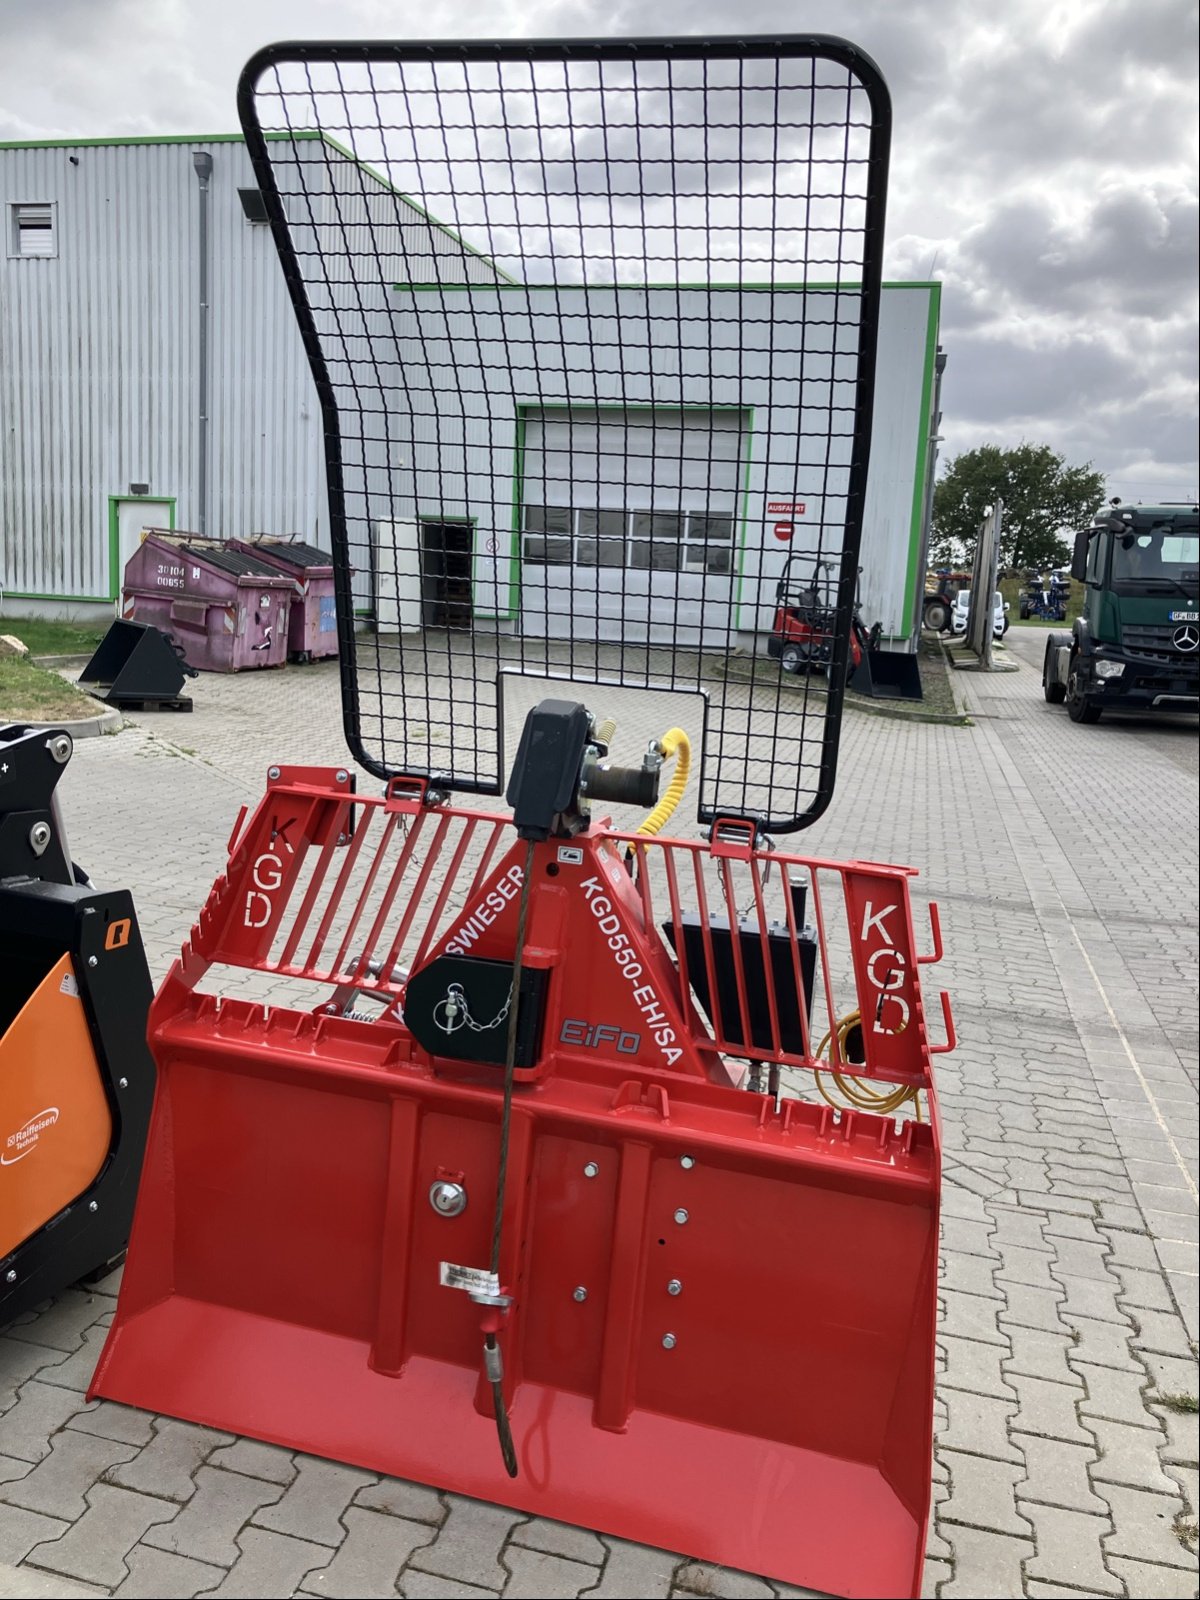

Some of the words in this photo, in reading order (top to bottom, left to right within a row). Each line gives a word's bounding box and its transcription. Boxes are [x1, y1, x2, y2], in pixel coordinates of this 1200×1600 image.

[244, 815, 297, 929] KGD
[579, 875, 684, 1066] KGD550-EH/SA
[861, 901, 910, 1036] KGD
[15, 1115, 56, 1143] Raiffeisen
[15, 1133, 40, 1150] Technik
